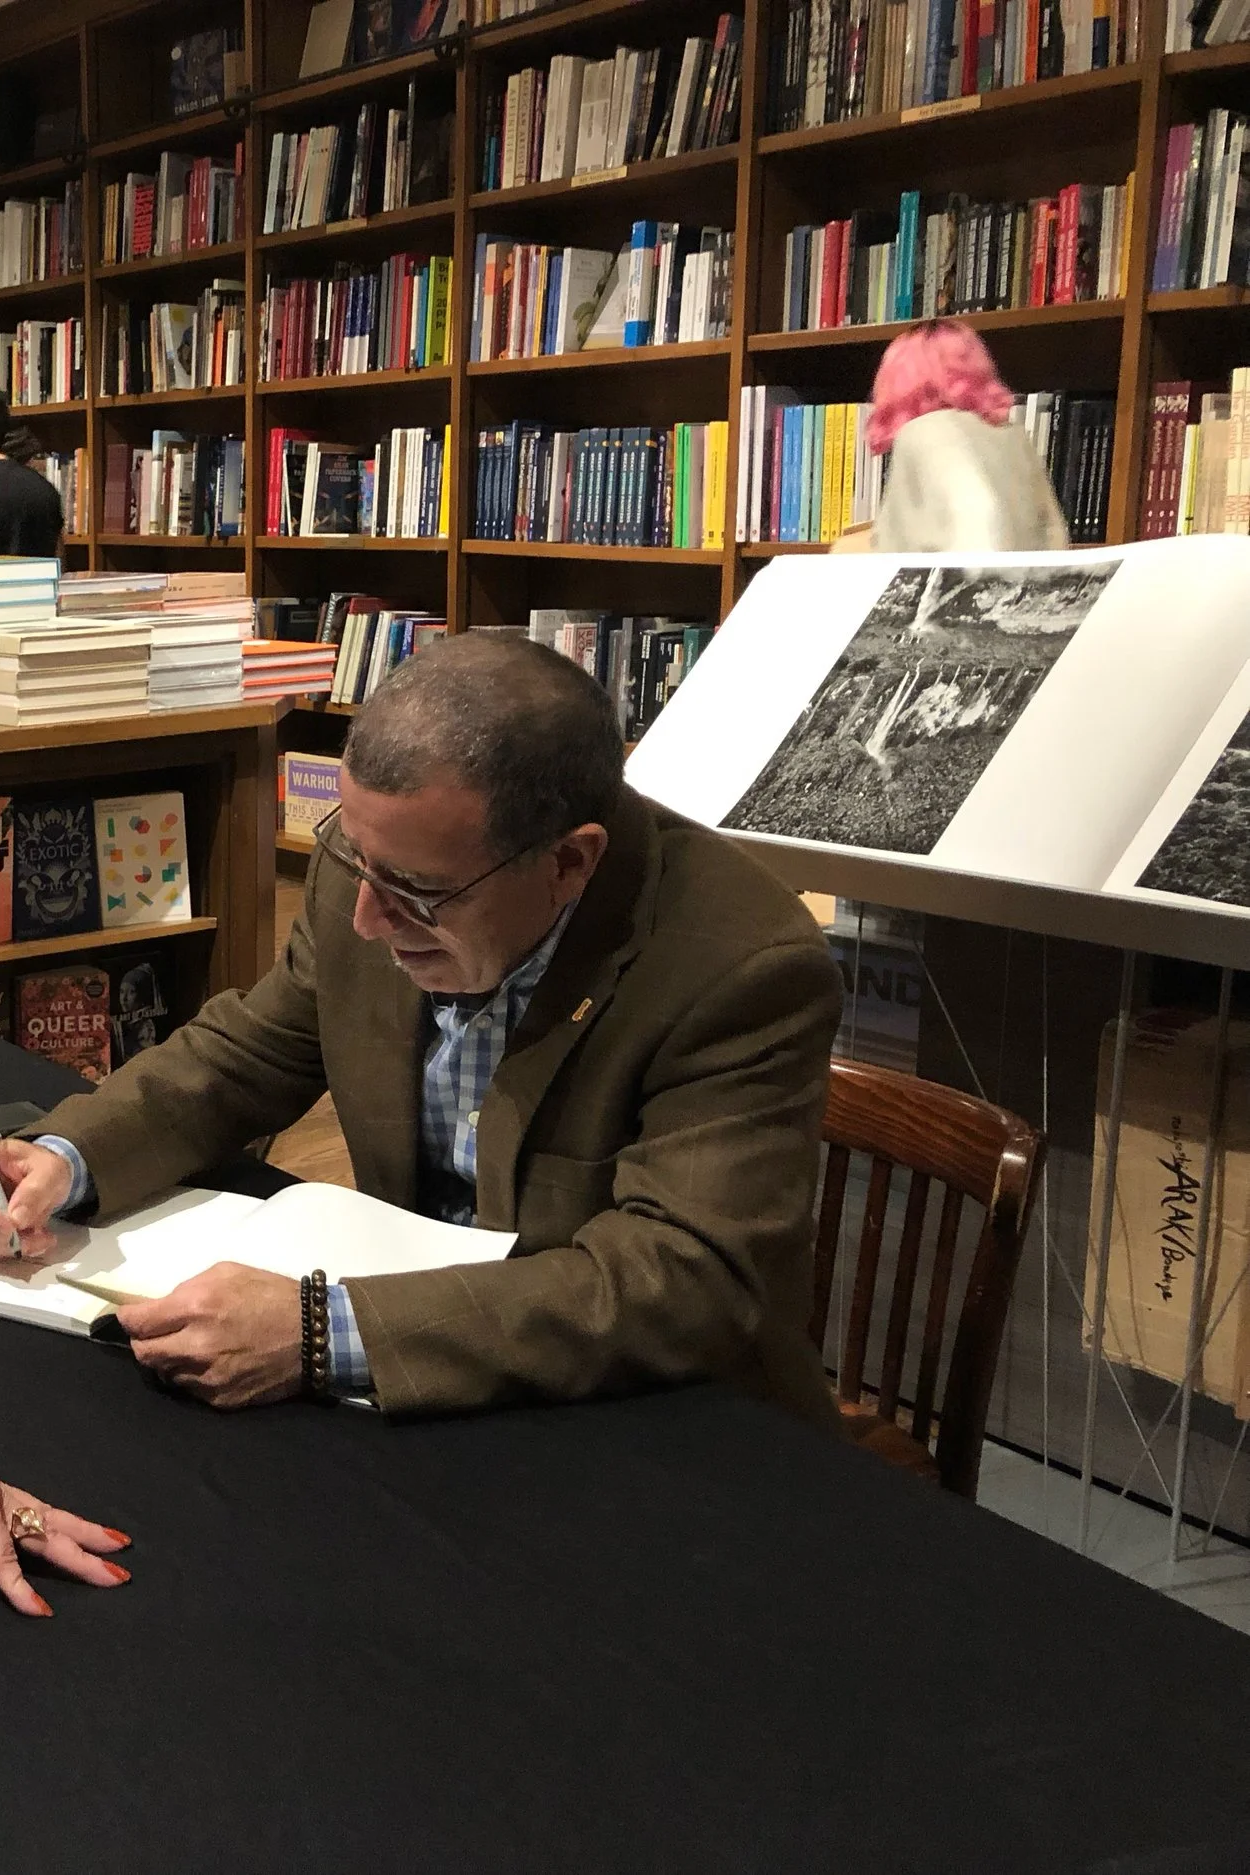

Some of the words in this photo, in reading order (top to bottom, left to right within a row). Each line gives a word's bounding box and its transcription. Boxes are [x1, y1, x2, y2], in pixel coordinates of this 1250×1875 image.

[292, 771, 339, 792] WARHOL
[289, 803, 307, 815] THIS
[30, 844, 79, 861] EXOTIC
[50, 1001, 73, 1012] ART
[76, 1001, 85, 1010] &
[28, 1014, 106, 1038] QUEER
[41, 1036, 95, 1050] CULTURE
